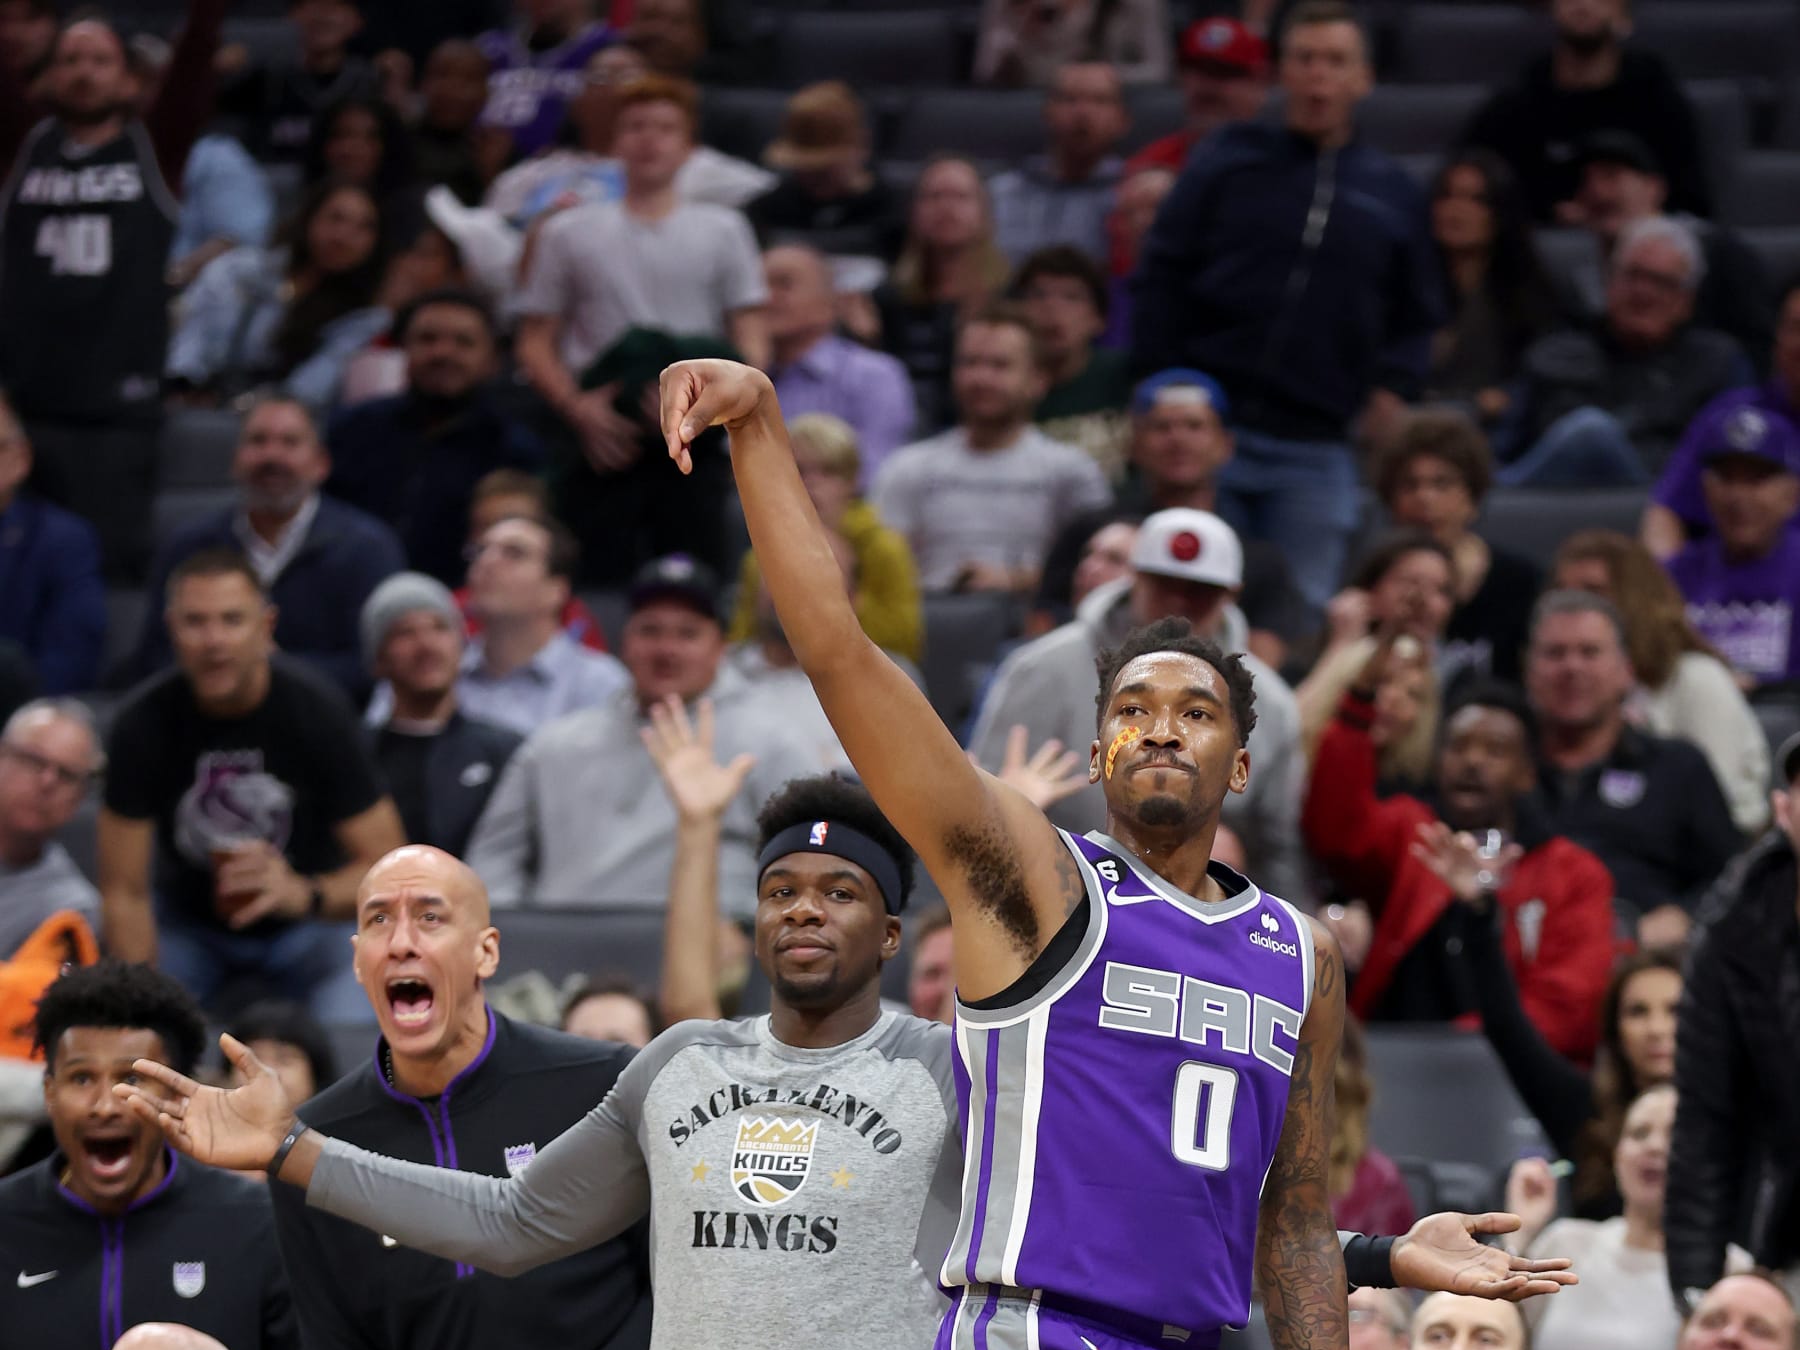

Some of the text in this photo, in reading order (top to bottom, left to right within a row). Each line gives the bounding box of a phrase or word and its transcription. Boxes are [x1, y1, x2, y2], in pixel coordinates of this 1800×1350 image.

[35, 214, 112, 275] 40
[1097, 861, 1120, 882] 6
[1249, 931, 1297, 957] dialpad
[1099, 961, 1302, 1077] SAC
[1170, 1060, 1239, 1172] 0
[734, 1152, 809, 1172] KINGS
[739, 1140, 810, 1152] SACRAMENTO
[691, 1211, 838, 1254] KINGS
